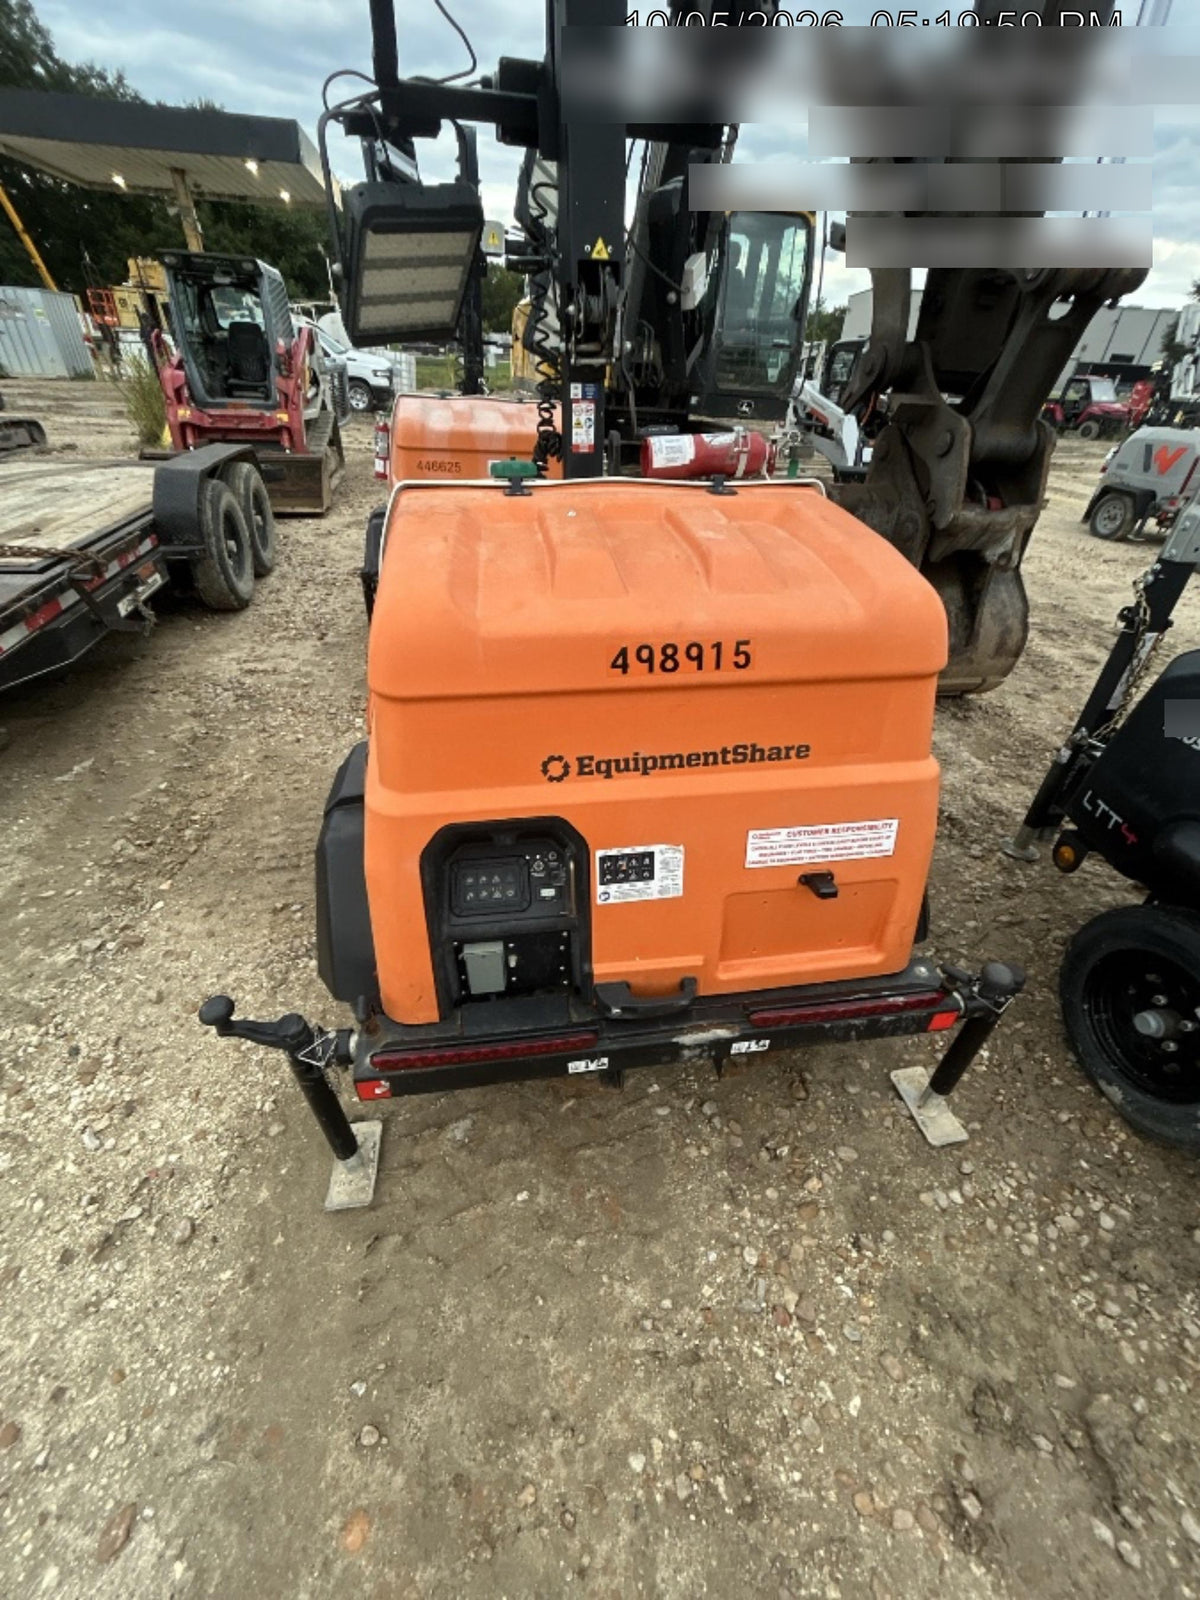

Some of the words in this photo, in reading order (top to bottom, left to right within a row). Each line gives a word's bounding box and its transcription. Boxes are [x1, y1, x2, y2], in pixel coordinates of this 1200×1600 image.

[610, 640, 751, 675] 498915
[576, 743, 811, 779] EquipmentShare
[1083, 790, 1138, 844] LTT4
